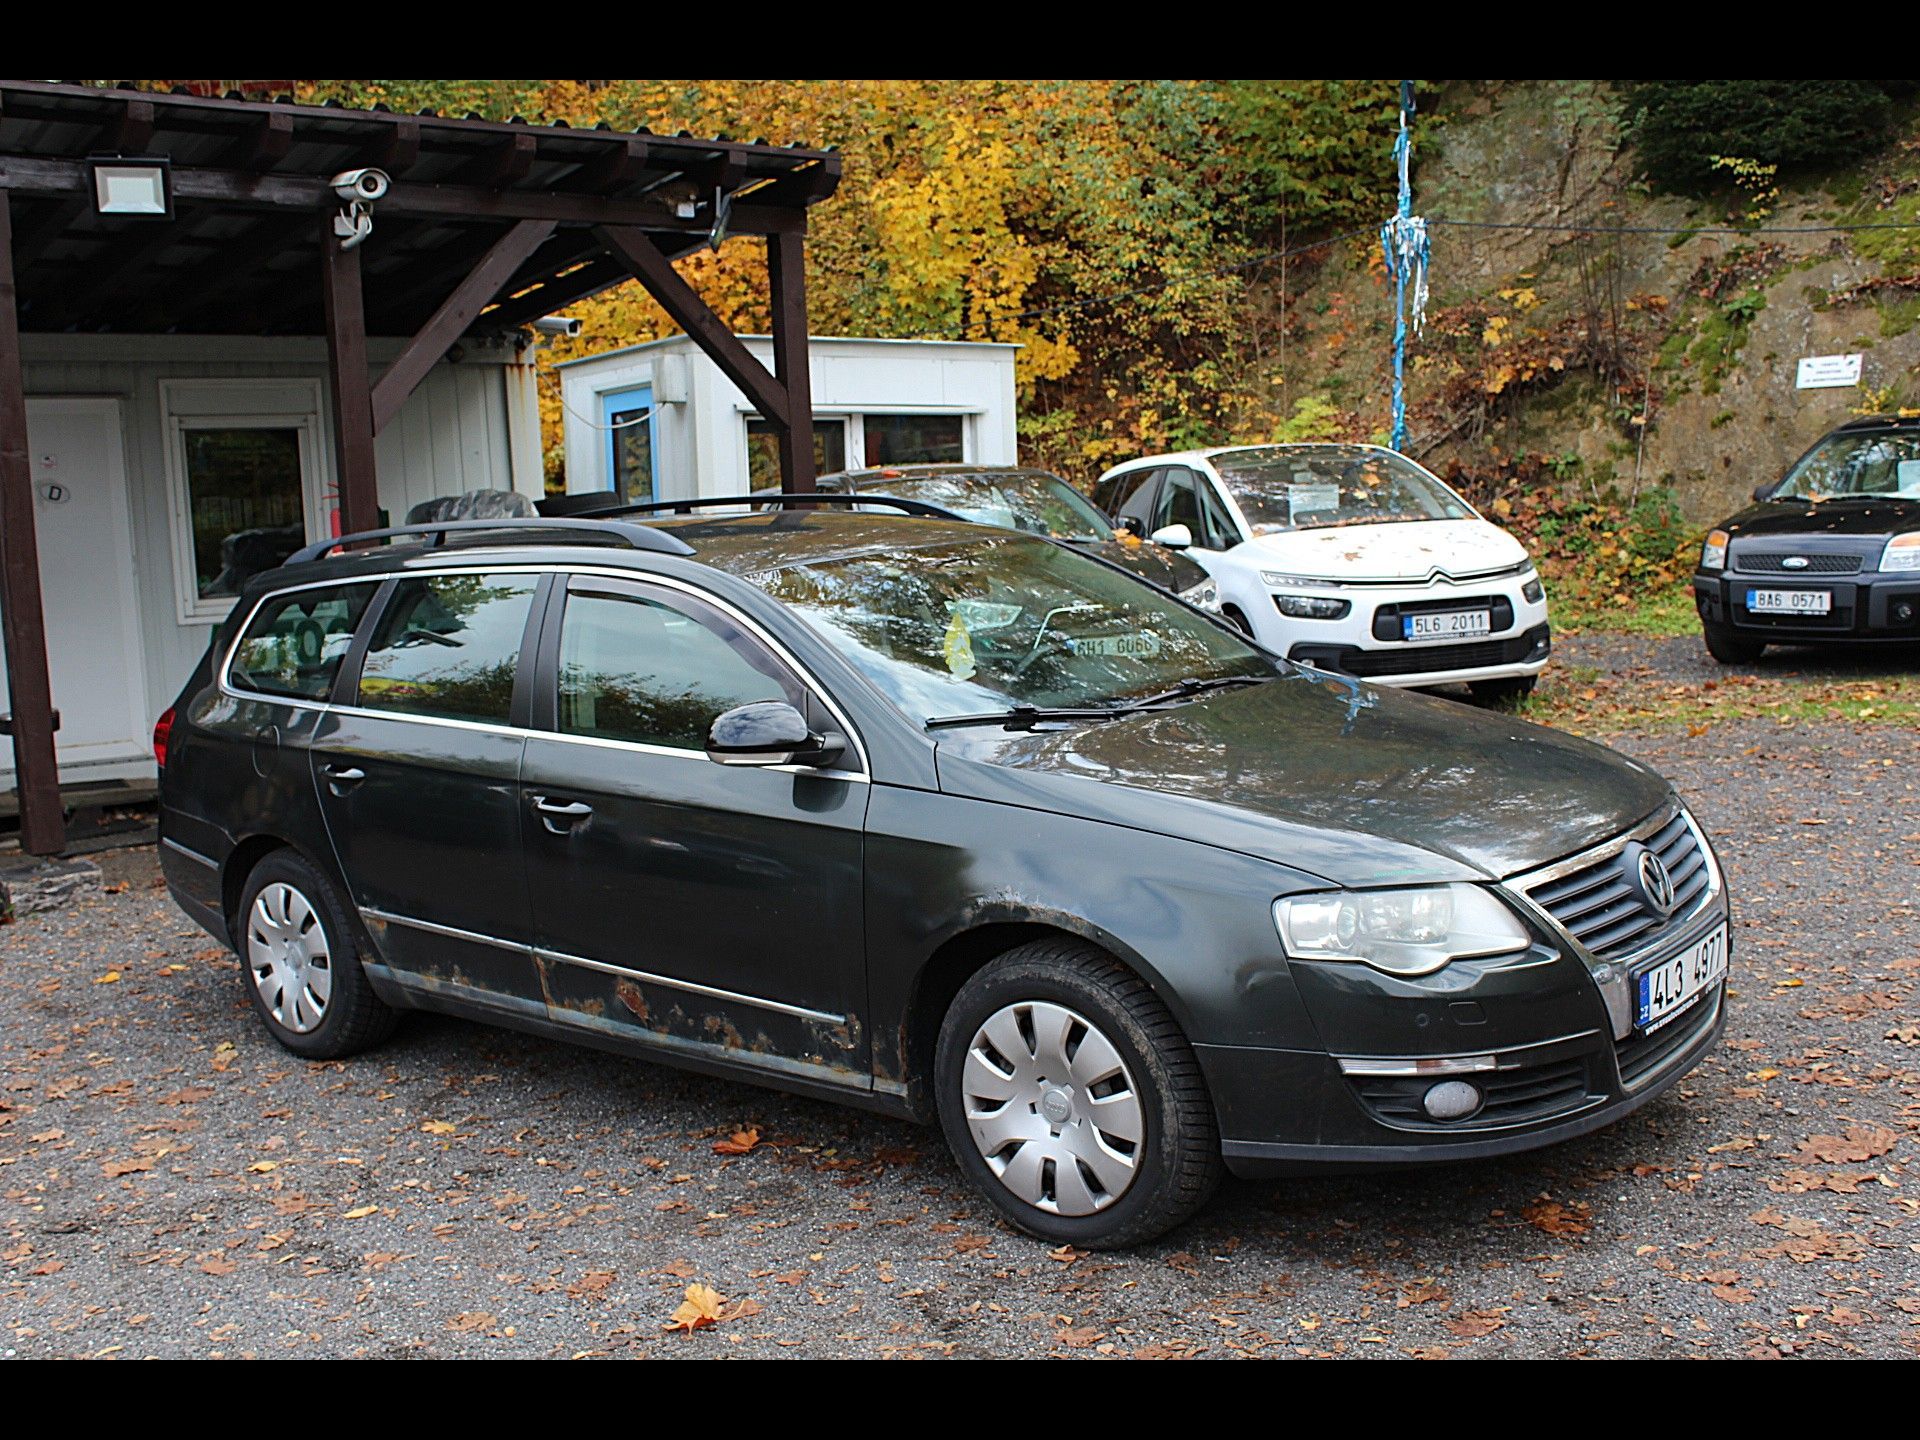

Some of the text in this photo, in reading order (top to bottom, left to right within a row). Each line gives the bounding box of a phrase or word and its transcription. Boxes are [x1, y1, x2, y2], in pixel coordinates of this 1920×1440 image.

[48, 485, 62, 501] D
[1758, 593, 1782, 607] 8A6
[1791, 594, 1824, 608] 0571
[1415, 617, 1441, 633] 5L6
[1451, 614, 1484, 631] 2011
[1653, 960, 1683, 1010] 4L3
[1694, 930, 1721, 984] 4977
